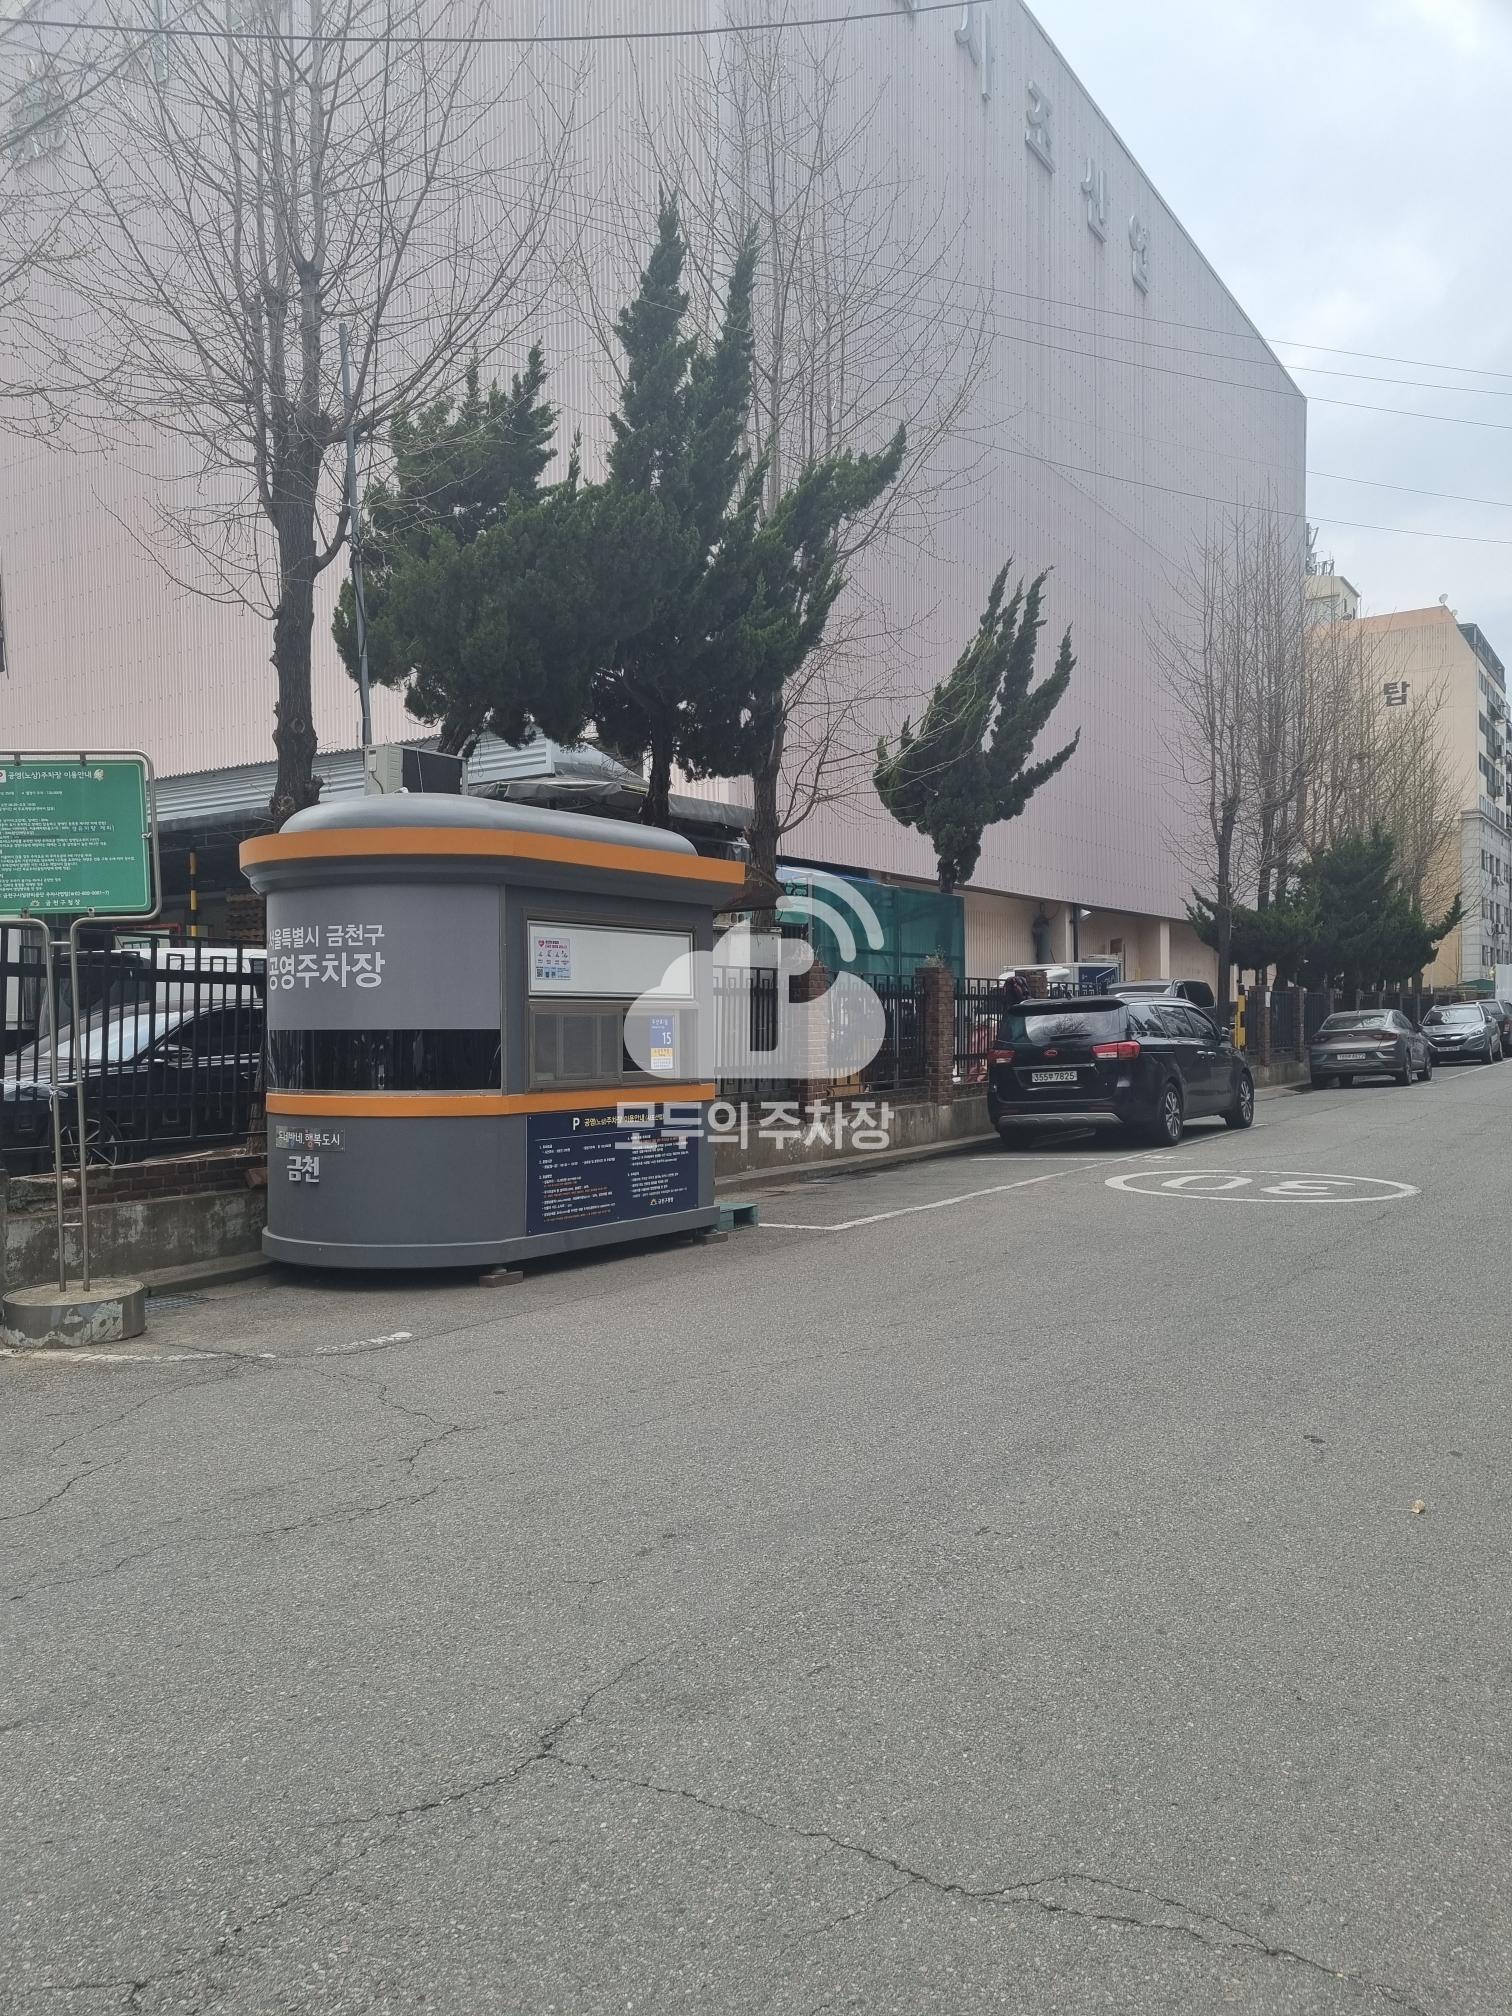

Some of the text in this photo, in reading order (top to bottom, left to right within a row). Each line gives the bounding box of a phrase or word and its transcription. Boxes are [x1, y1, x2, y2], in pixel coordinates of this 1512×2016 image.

[1383, 681, 1410, 707] 탑
[64, 770, 92, 780] 이용안내
[268, 923, 385, 950] 서울특별시 금천구
[268, 951, 385, 990] 공영주차장
[661, 1031, 672, 1045] 15
[304, 1129, 340, 1148] 행복도시
[286, 1155, 320, 1183] 금천
